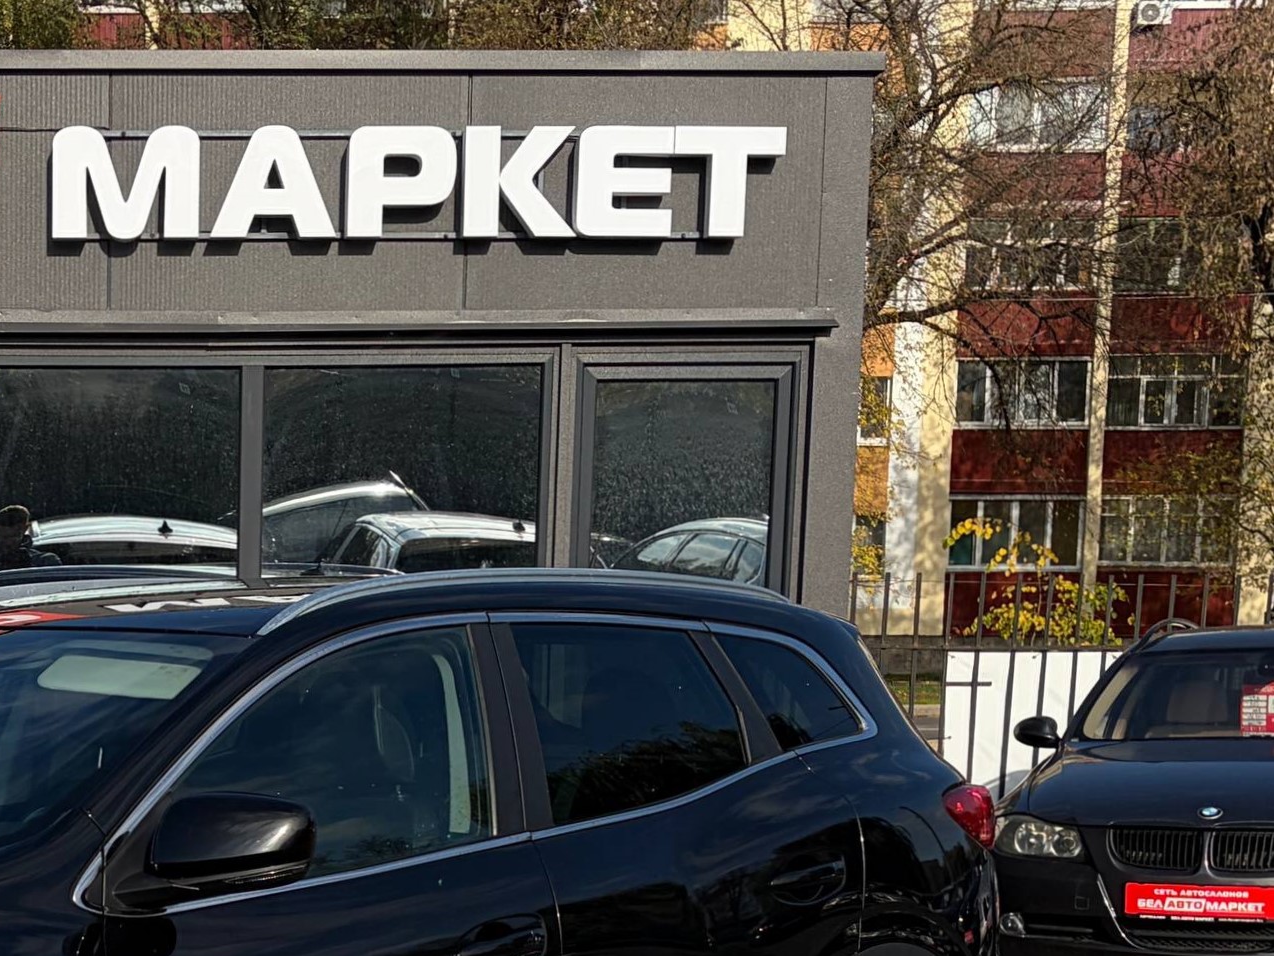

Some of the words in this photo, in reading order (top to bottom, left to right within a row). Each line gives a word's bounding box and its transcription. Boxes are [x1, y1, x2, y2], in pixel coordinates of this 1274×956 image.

[51, 124, 788, 241] МАРКЕТ
[1153, 888, 1178, 896] СЕТЬ
[1179, 889, 1249, 898] АВТОСАЛОНОВ
[1137, 898, 1163, 909] БЕЛ
[1167, 900, 1203, 909] АВТО
[1206, 901, 1265, 912] МАРКЕТ
